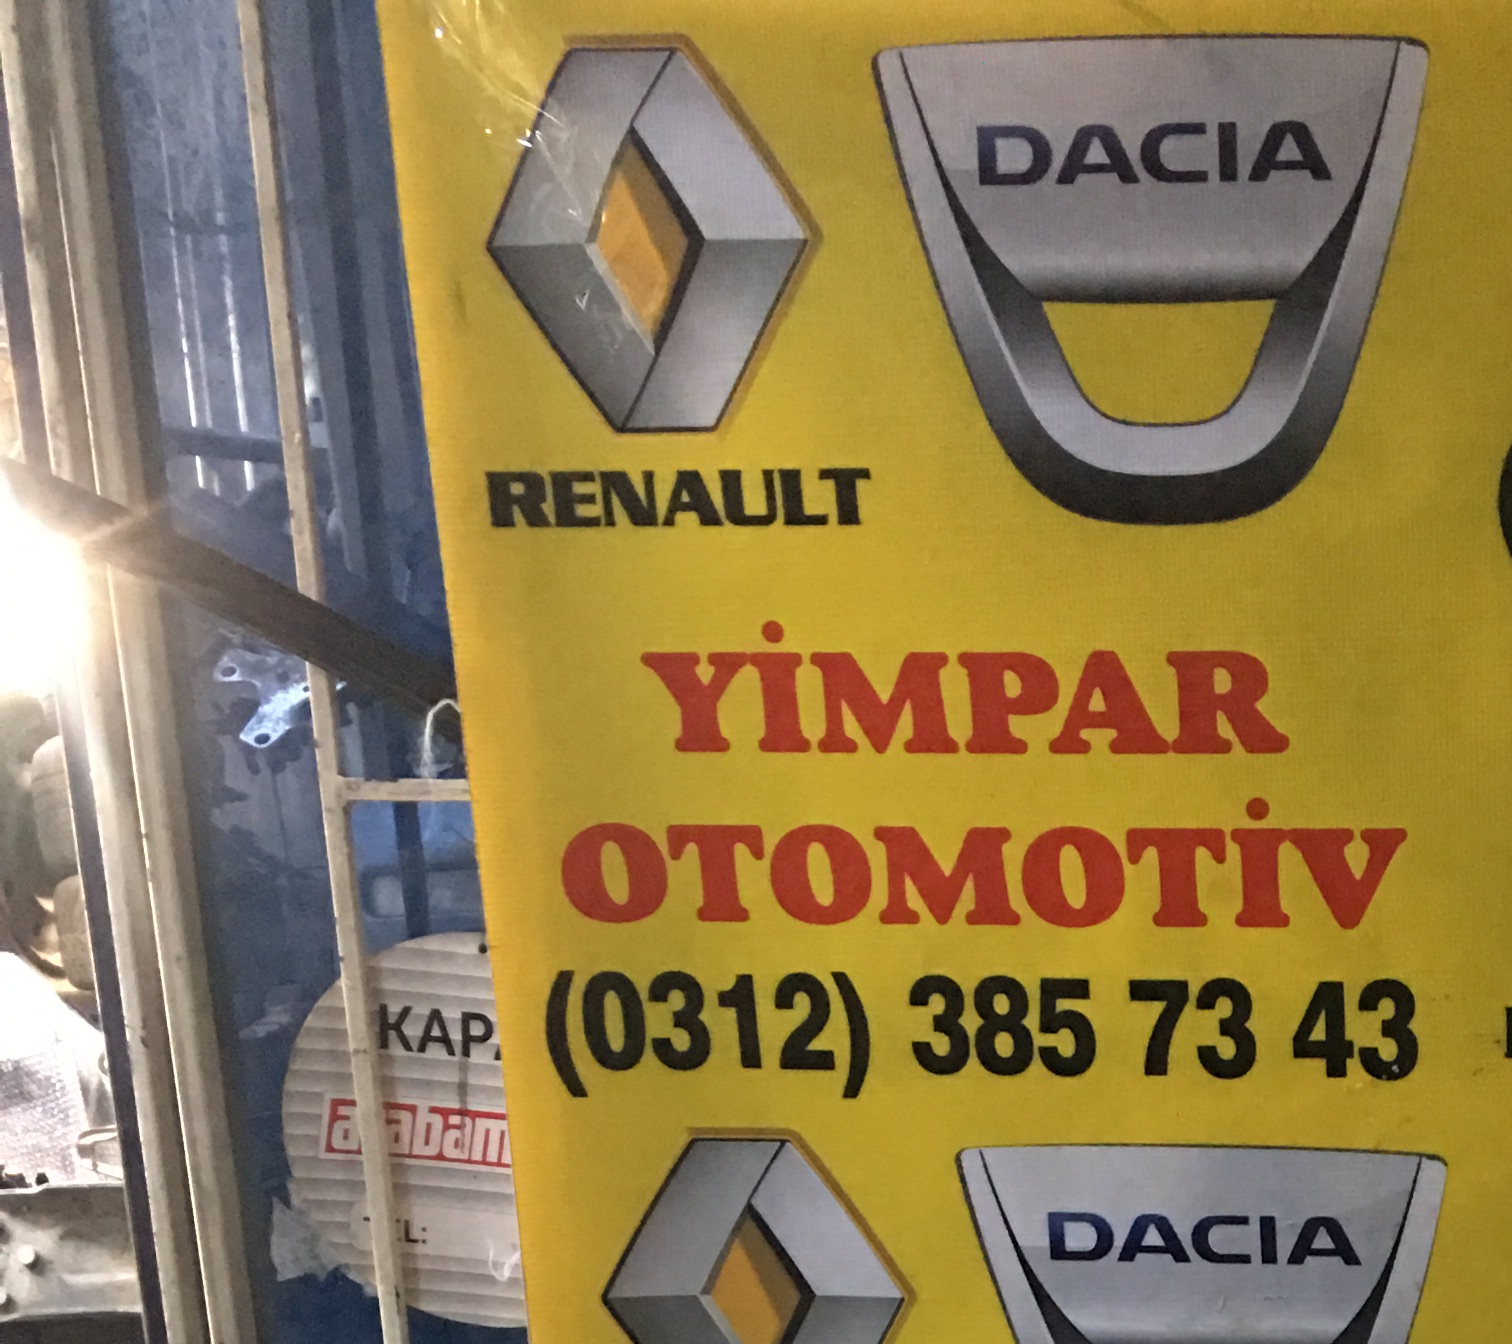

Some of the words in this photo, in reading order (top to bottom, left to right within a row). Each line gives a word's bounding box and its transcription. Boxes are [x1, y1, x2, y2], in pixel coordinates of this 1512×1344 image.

[976, 120, 1333, 186] DACIA
[486, 468, 871, 528] RENAULT
[644, 620, 1288, 753] YİMPAR
[563, 799, 1406, 928] OTOMOTİV
[379, 1003, 502, 1061] KAP
[547, 970, 867, 1099] (0312)
[909, 975, 1096, 1077] 385
[1129, 978, 1257, 1080] 73
[1292, 978, 1418, 1082] 43
[1048, 1212, 1363, 1268] DACIA
